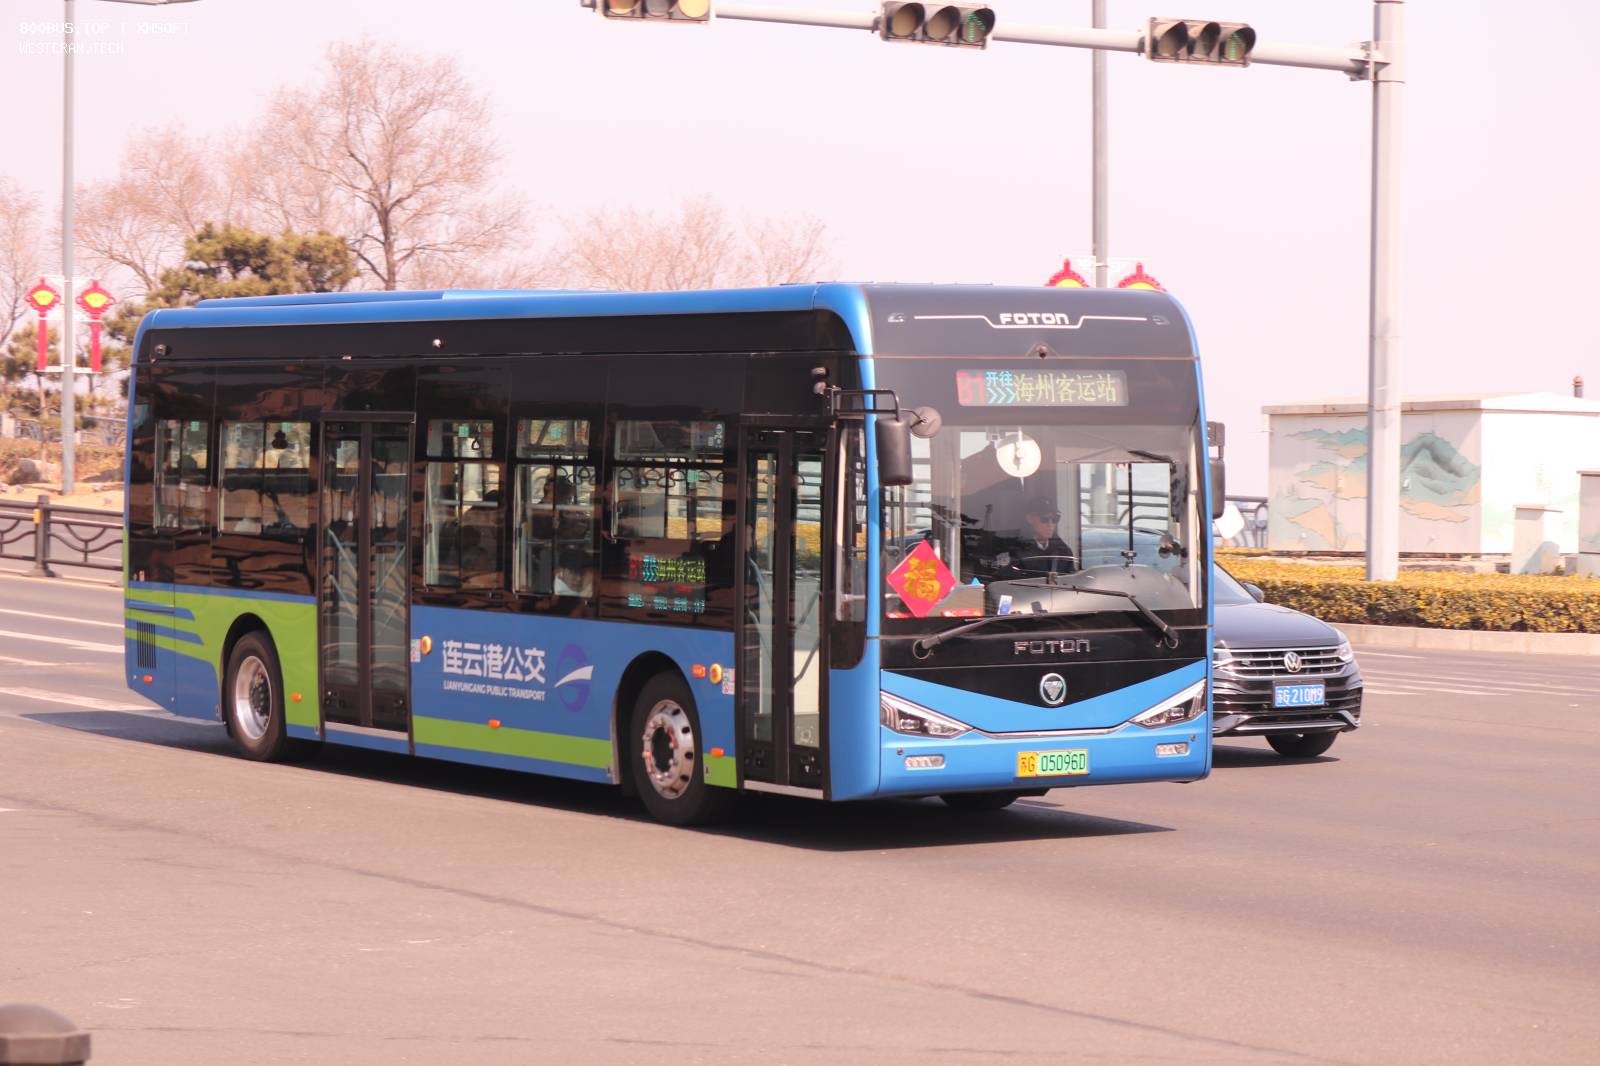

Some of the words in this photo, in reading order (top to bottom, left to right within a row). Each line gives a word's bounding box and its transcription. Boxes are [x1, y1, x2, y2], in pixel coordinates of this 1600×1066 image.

[999, 312, 1070, 325] FOTON
[985, 370, 1014, 387] 开往
[1014, 373, 1118, 403] 海州客运站
[903, 556, 941, 602] 福
[1014, 639, 1091, 655] FOTON
[442, 639, 547, 684] 连云港公交
[443, 680, 486, 695] LIANYUNGANG
[486, 684, 508, 697] PUBLIC
[508, 686, 546, 702] TRANSPORT
